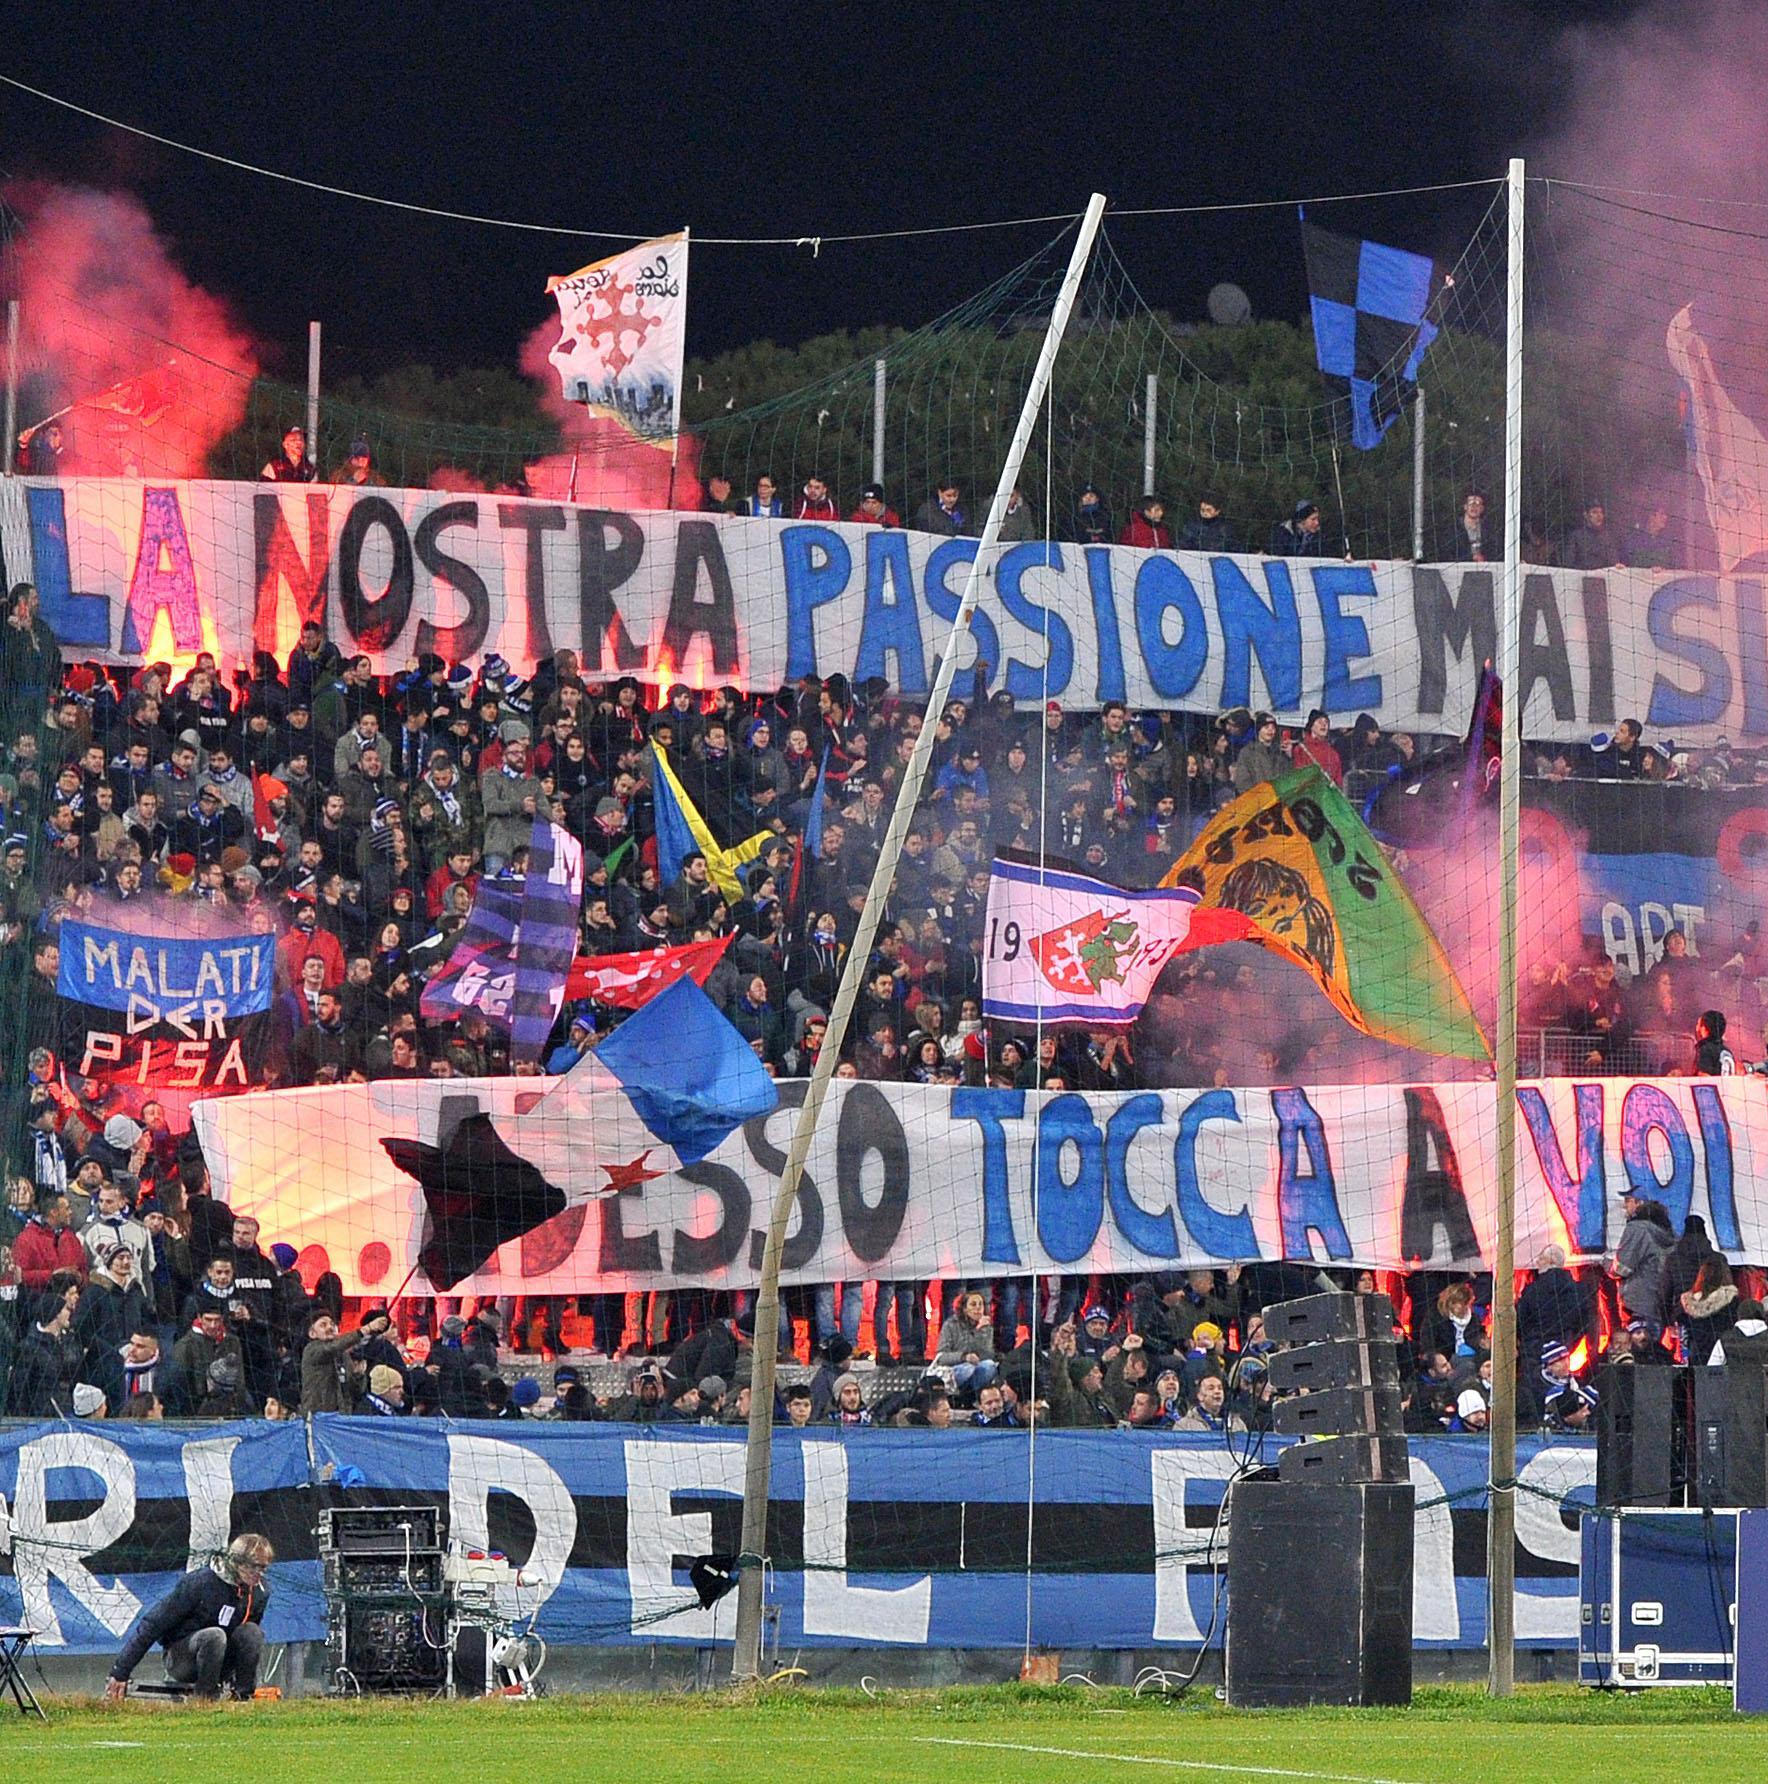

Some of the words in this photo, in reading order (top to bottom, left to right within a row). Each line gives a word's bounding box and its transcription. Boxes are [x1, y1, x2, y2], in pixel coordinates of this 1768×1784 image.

[25, 487, 203, 655] LA
[253, 492, 740, 675] NOSTRA
[779, 525, 1383, 712] PASSIONE
[1414, 565, 1616, 723] MAI
[84, 936, 261, 998] MALATI
[127, 992, 228, 1041] DER
[79, 1031, 248, 1086] PISA
[950, 1086, 1353, 1264] TOCCA
[1402, 1086, 1482, 1262] A
[1515, 1084, 1744, 1255] VOI
[0, 1432, 241, 1645] RI
[447, 1434, 931, 1643] DEL
